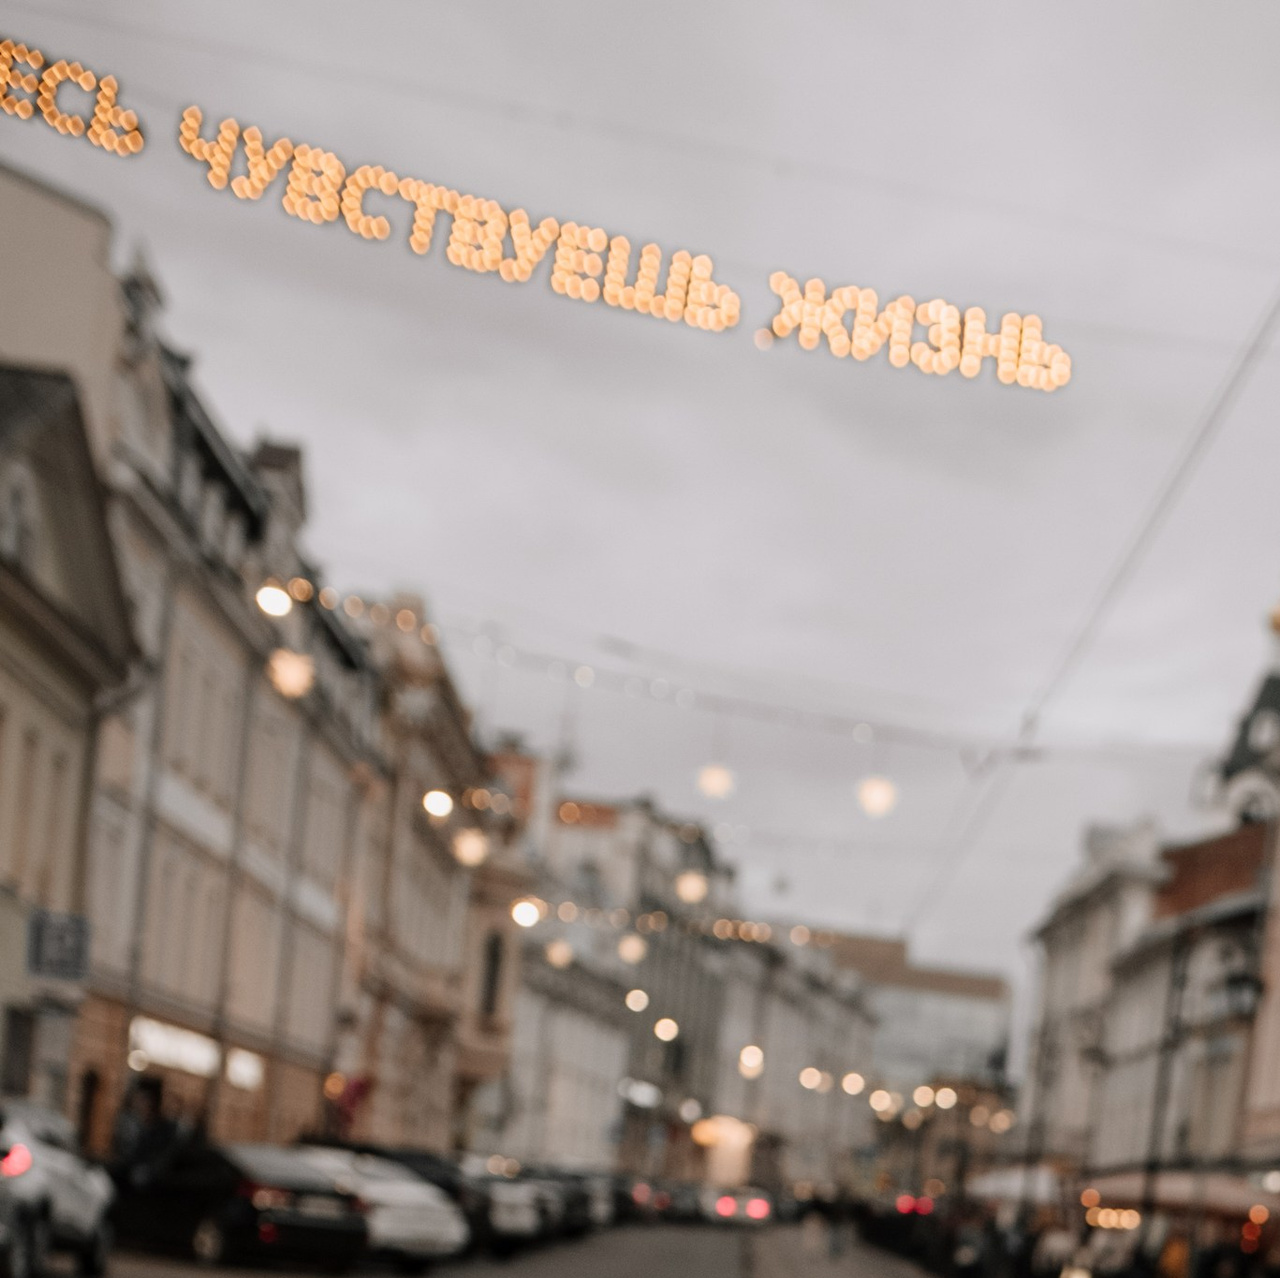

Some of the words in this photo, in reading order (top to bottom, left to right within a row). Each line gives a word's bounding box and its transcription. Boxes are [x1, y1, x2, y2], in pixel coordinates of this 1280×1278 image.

[0, 39, 144, 157] ЕСЬ
[179, 106, 740, 331] ЧУВСТВУЕШЬ
[770, 272, 1071, 392] ЖИЗНЬ
